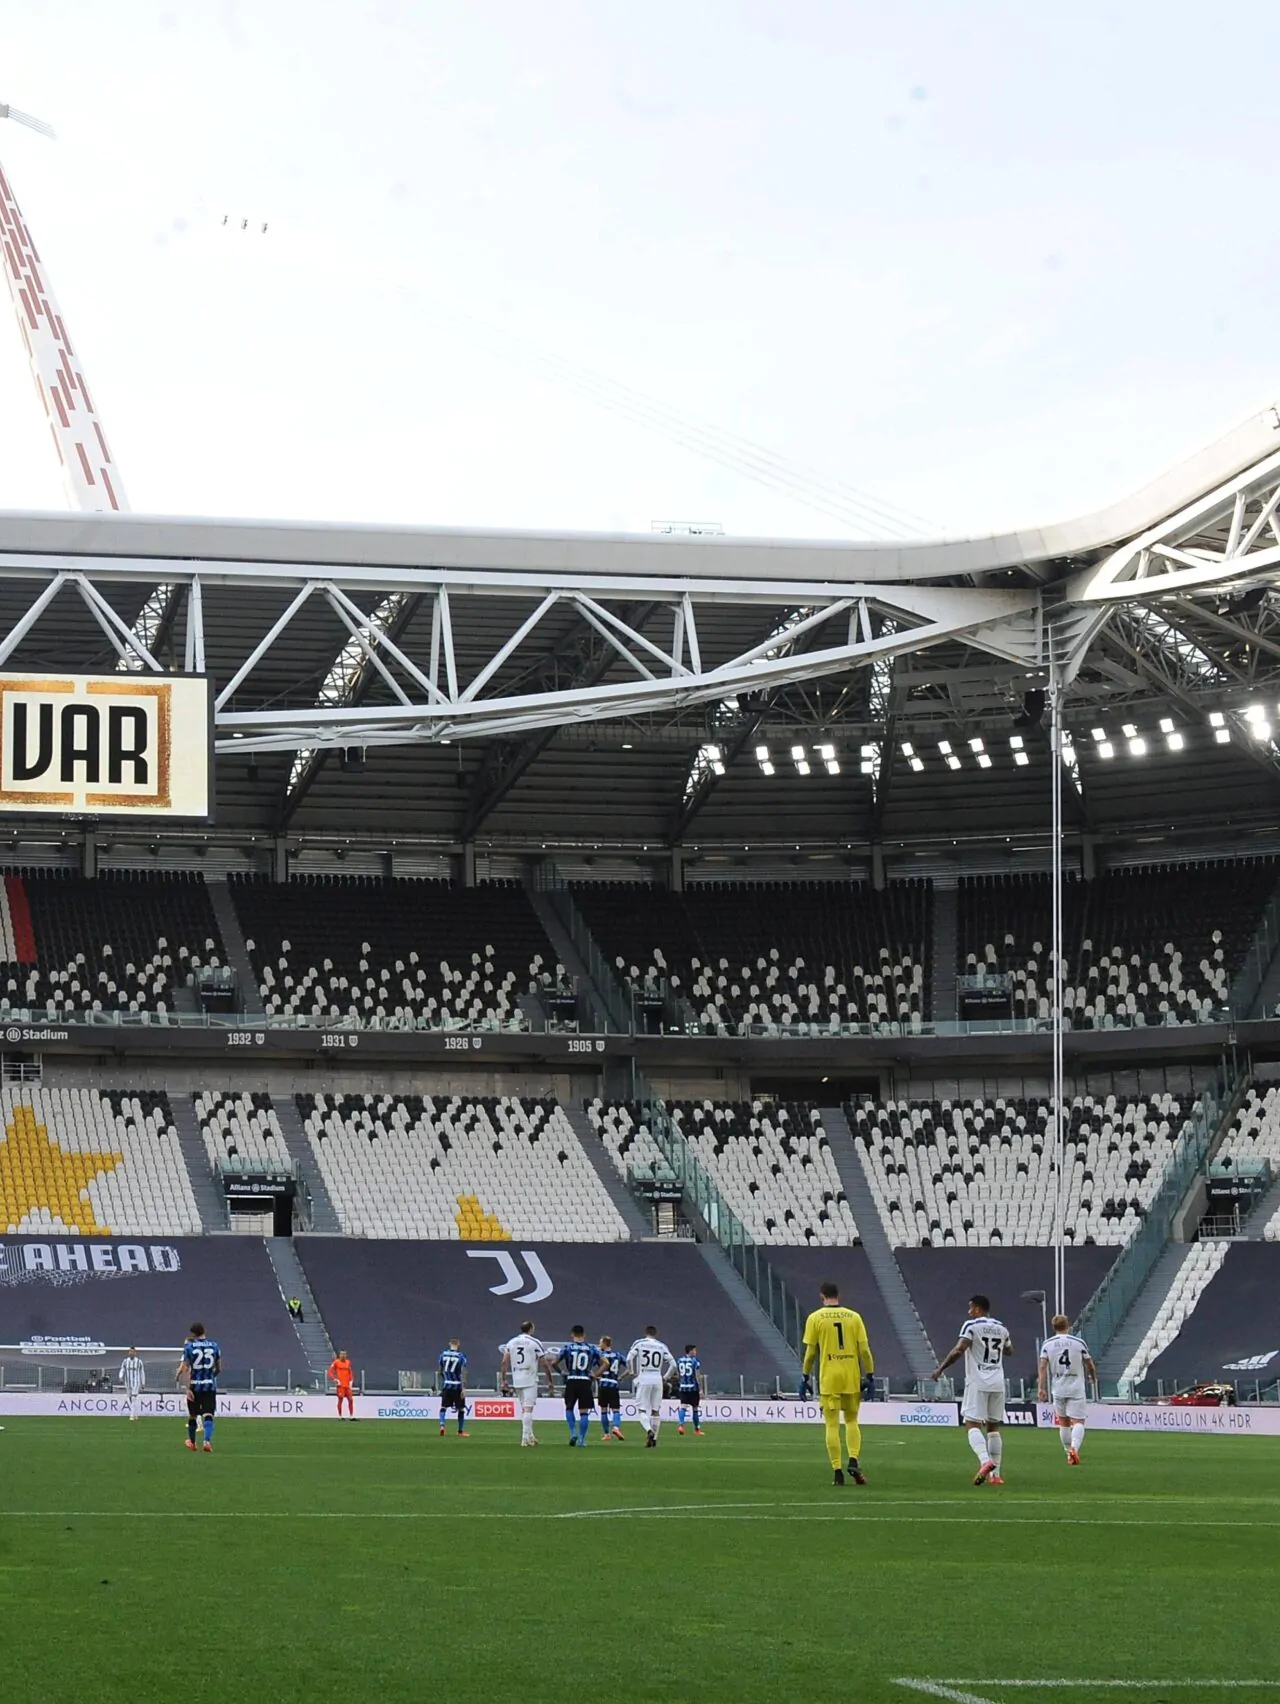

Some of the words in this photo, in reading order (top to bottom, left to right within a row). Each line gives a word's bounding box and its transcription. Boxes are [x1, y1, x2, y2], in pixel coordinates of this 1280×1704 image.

[13, 702, 149, 785] VAR
[22, 1028, 69, 1041] Stadium
[227, 1032, 252, 1045] 1932
[321, 1034, 346, 1047] 1931
[444, 1037, 469, 1050] 1926
[568, 1040, 593, 1052] 1905
[22, 1243, 181, 1273] AHEAD
[833, 1322, 845, 1350] 1
[516, 1346, 525, 1365] 3
[982, 1336, 1002, 1364] 13
[191, 1348, 215, 1370] 23
[442, 1356, 460, 1373] 77
[570, 1351, 589, 1371] 10
[640, 1349, 662, 1369] 30
[1058, 1348, 1072, 1370] 4
[678, 1361, 693, 1377] 95
[58, 1399, 131, 1412] ANCORA
[140, 1400, 187, 1413] MEGL
[240, 1401, 261, 1414] 4K
[269, 1401, 304, 1414] HDR
[378, 1408, 429, 1418] EURO2020
[477, 1403, 512, 1415] sport
[740, 1406, 757, 1419] IN
[766, 1406, 786, 1419] 4K
[899, 1414, 950, 1424] EURO2020
[1041, 1409, 1053, 1423] sky
[1111, 1410, 1151, 1425] ANCORA
[1154, 1411, 1193, 1427] MEGLIO
[1195, 1413, 1208, 1427] IN
[1211, 1413, 1226, 1428] 4K
[1228, 1413, 1252, 1429] HDR
